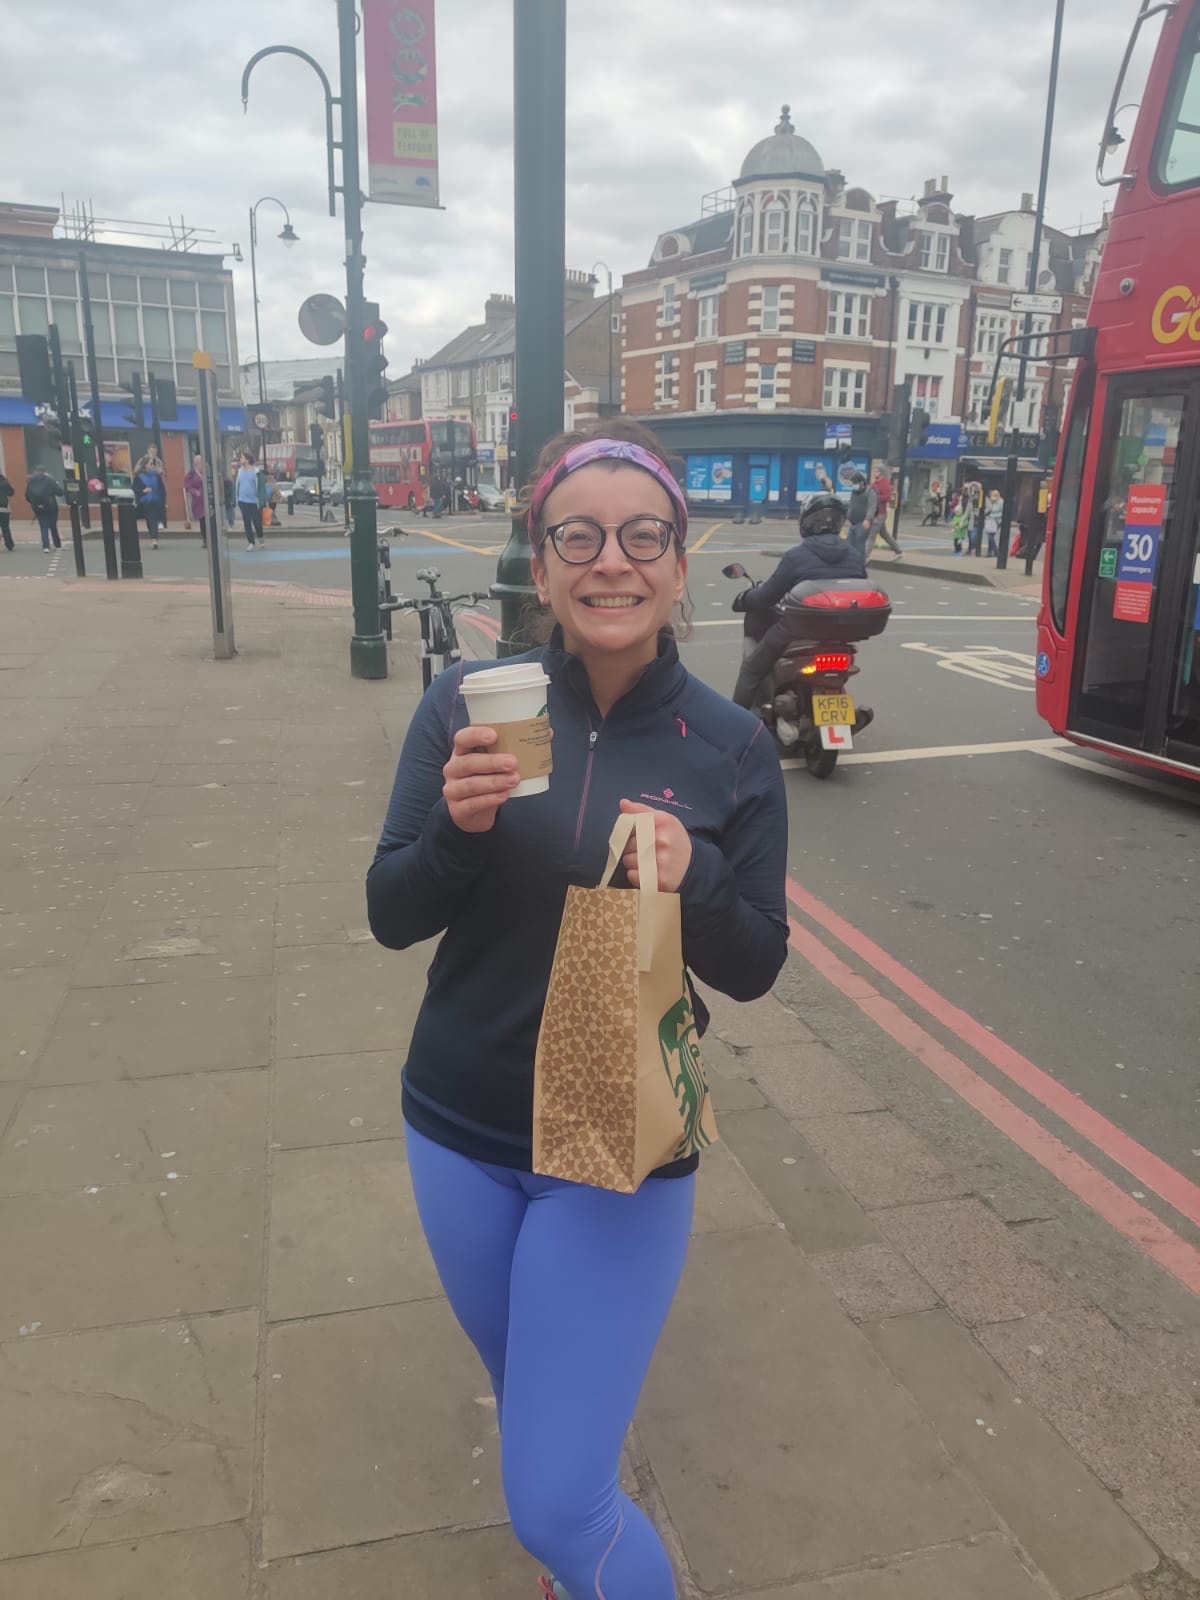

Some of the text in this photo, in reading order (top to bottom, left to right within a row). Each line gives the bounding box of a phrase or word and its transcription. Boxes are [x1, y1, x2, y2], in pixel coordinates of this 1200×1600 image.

[1131, 496, 1161, 504] Maximum
[1132, 506, 1158, 515] capacity
[1125, 534, 1153, 561] 30
[818, 697, 848, 709] KF16
[821, 710, 847, 722] CRV
[828, 726, 844, 744] L
